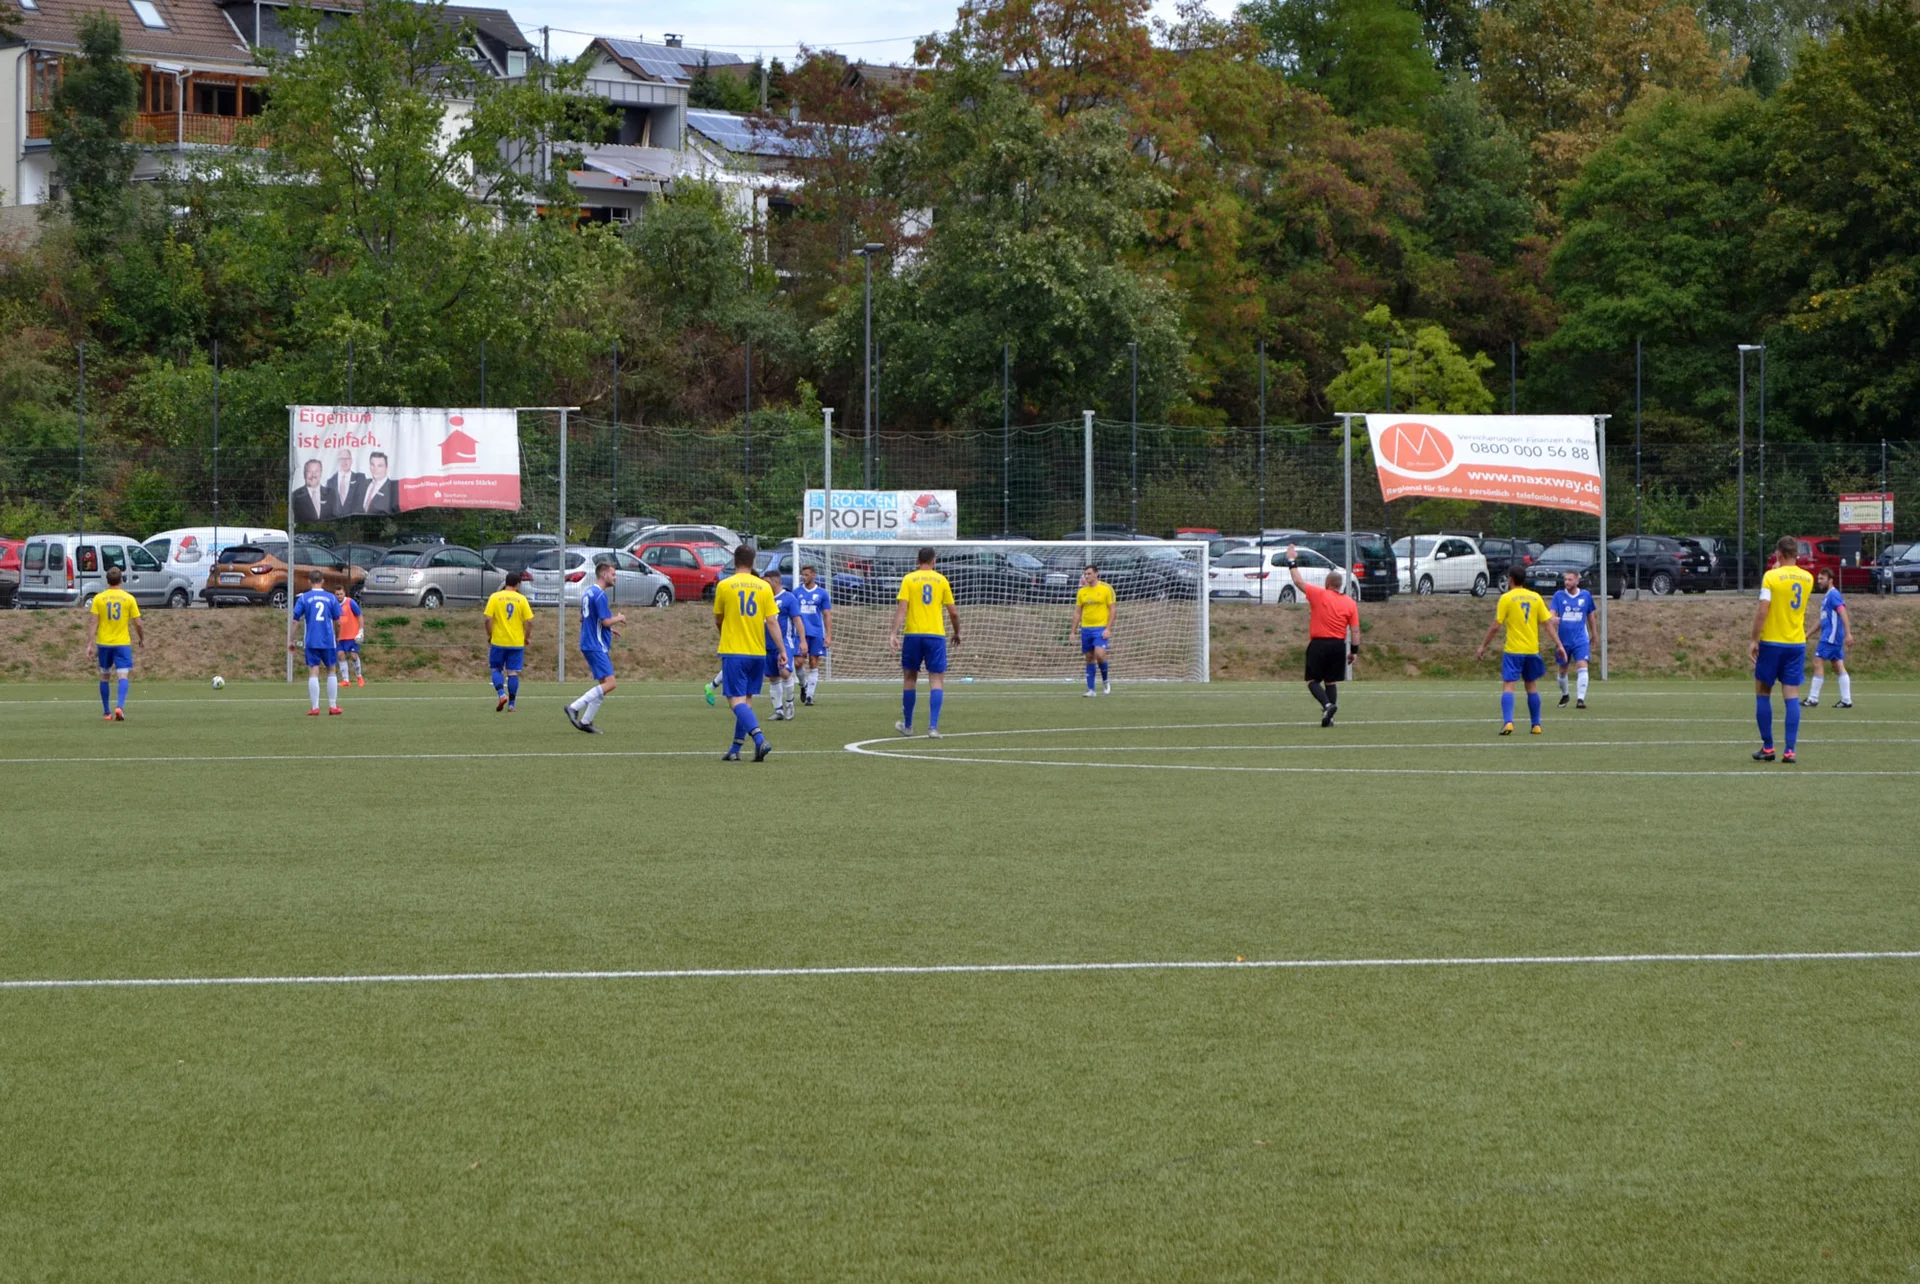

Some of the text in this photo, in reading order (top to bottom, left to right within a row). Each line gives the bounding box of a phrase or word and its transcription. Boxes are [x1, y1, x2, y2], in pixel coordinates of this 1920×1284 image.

[300, 408, 372, 428] Eigentum
[298, 431, 381, 448] ist einfach.
[1458, 434, 1522, 444] Versicherungen
[1470, 442, 1590, 460] 0800 000 56 88
[1467, 470, 1600, 494] www.maxxway.de
[818, 494, 896, 508] TROCKEN
[1386, 484, 1422, 496] Regional
[1469, 488, 1510, 498] persönlich
[1516, 491, 1558, 502] telefonisch
[810, 509, 898, 528] PROFIS
[738, 590, 757, 616] 16
[922, 584, 932, 605] 8
[1790, 582, 1802, 610] 3
[106, 602, 122, 620] 13
[315, 601, 325, 622] 2
[506, 602, 514, 620] 9
[1521, 602, 1530, 623] 7
